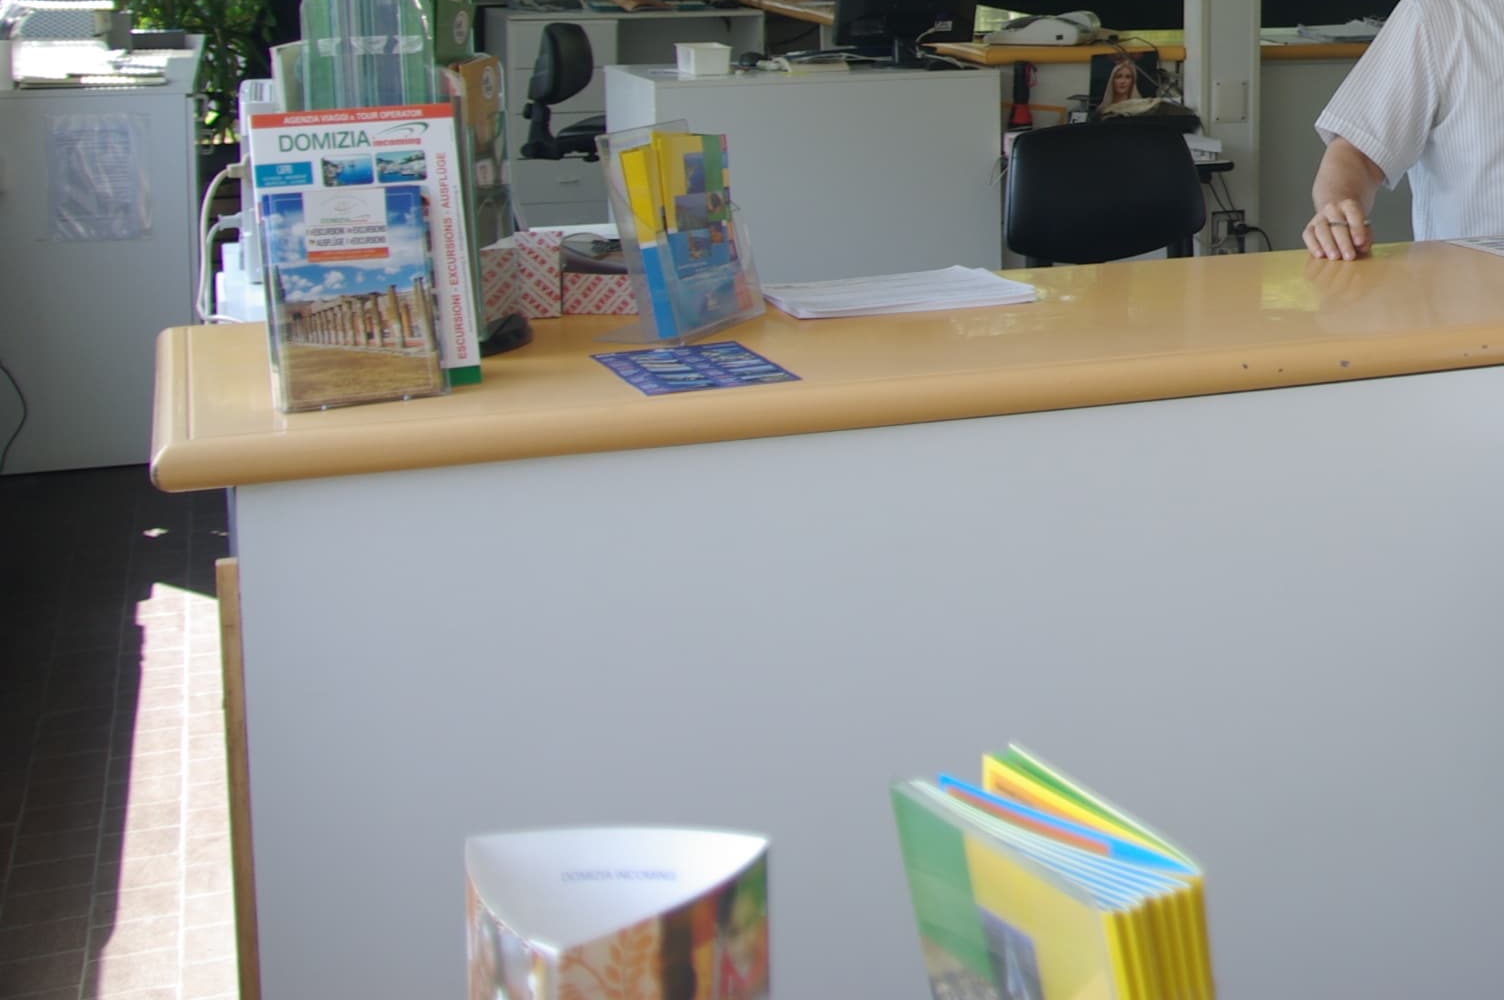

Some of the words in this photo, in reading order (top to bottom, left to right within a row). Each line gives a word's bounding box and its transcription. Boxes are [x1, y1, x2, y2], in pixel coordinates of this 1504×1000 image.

[278, 130, 371, 152] DOMIZIA
[283, 114, 319, 125] AGENZIA
[356, 111, 378, 120] TOUR
[379, 109, 423, 119] OPERATOR
[435, 152, 450, 208] AUSFLÜGE
[442, 217, 459, 285] EXCURSIONS
[450, 293, 467, 360] ESCURSIONI
